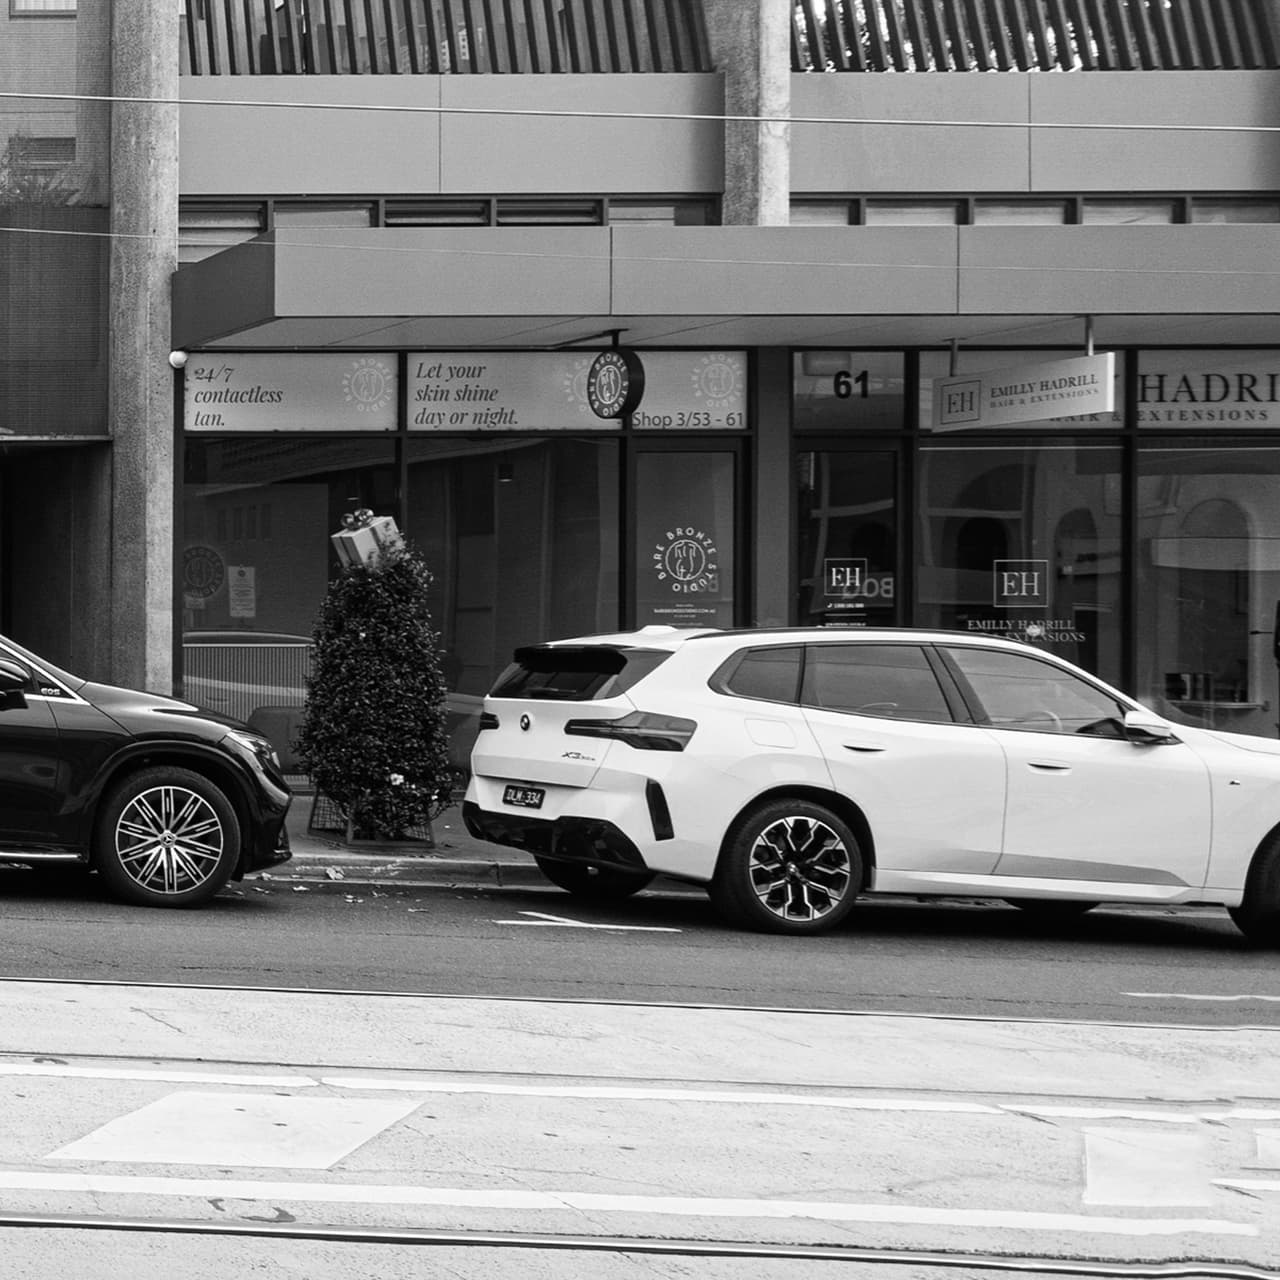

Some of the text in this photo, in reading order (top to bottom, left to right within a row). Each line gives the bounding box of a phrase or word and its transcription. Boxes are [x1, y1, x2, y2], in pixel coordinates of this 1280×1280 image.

[194, 364, 235, 383] 24/7
[416, 362, 486, 382] Let your
[415, 384, 499, 402] skin shine
[833, 370, 869, 399] 61
[991, 373, 1100, 398] EMILLY HADRILL
[194, 386, 284, 404] contactless
[947, 391, 974, 414] EH
[1030, 387, 1100, 404] EXTENSIONS
[194, 411, 226, 427] tan.
[414, 407, 518, 428] day or night.
[632, 412, 673, 430] Shop
[676, 411, 711, 427] 3/53
[726, 412, 744, 426] 61
[1137, 409, 1269, 421] EXTENSIONS
[666, 527, 717, 554] BRONZE
[653, 544, 667, 580] BARE
[672, 563, 717, 593] STUDIO
[831, 568, 860, 587] EH
[1001, 571, 1040, 596] EH
[967, 619, 1013, 630] EMILLY
